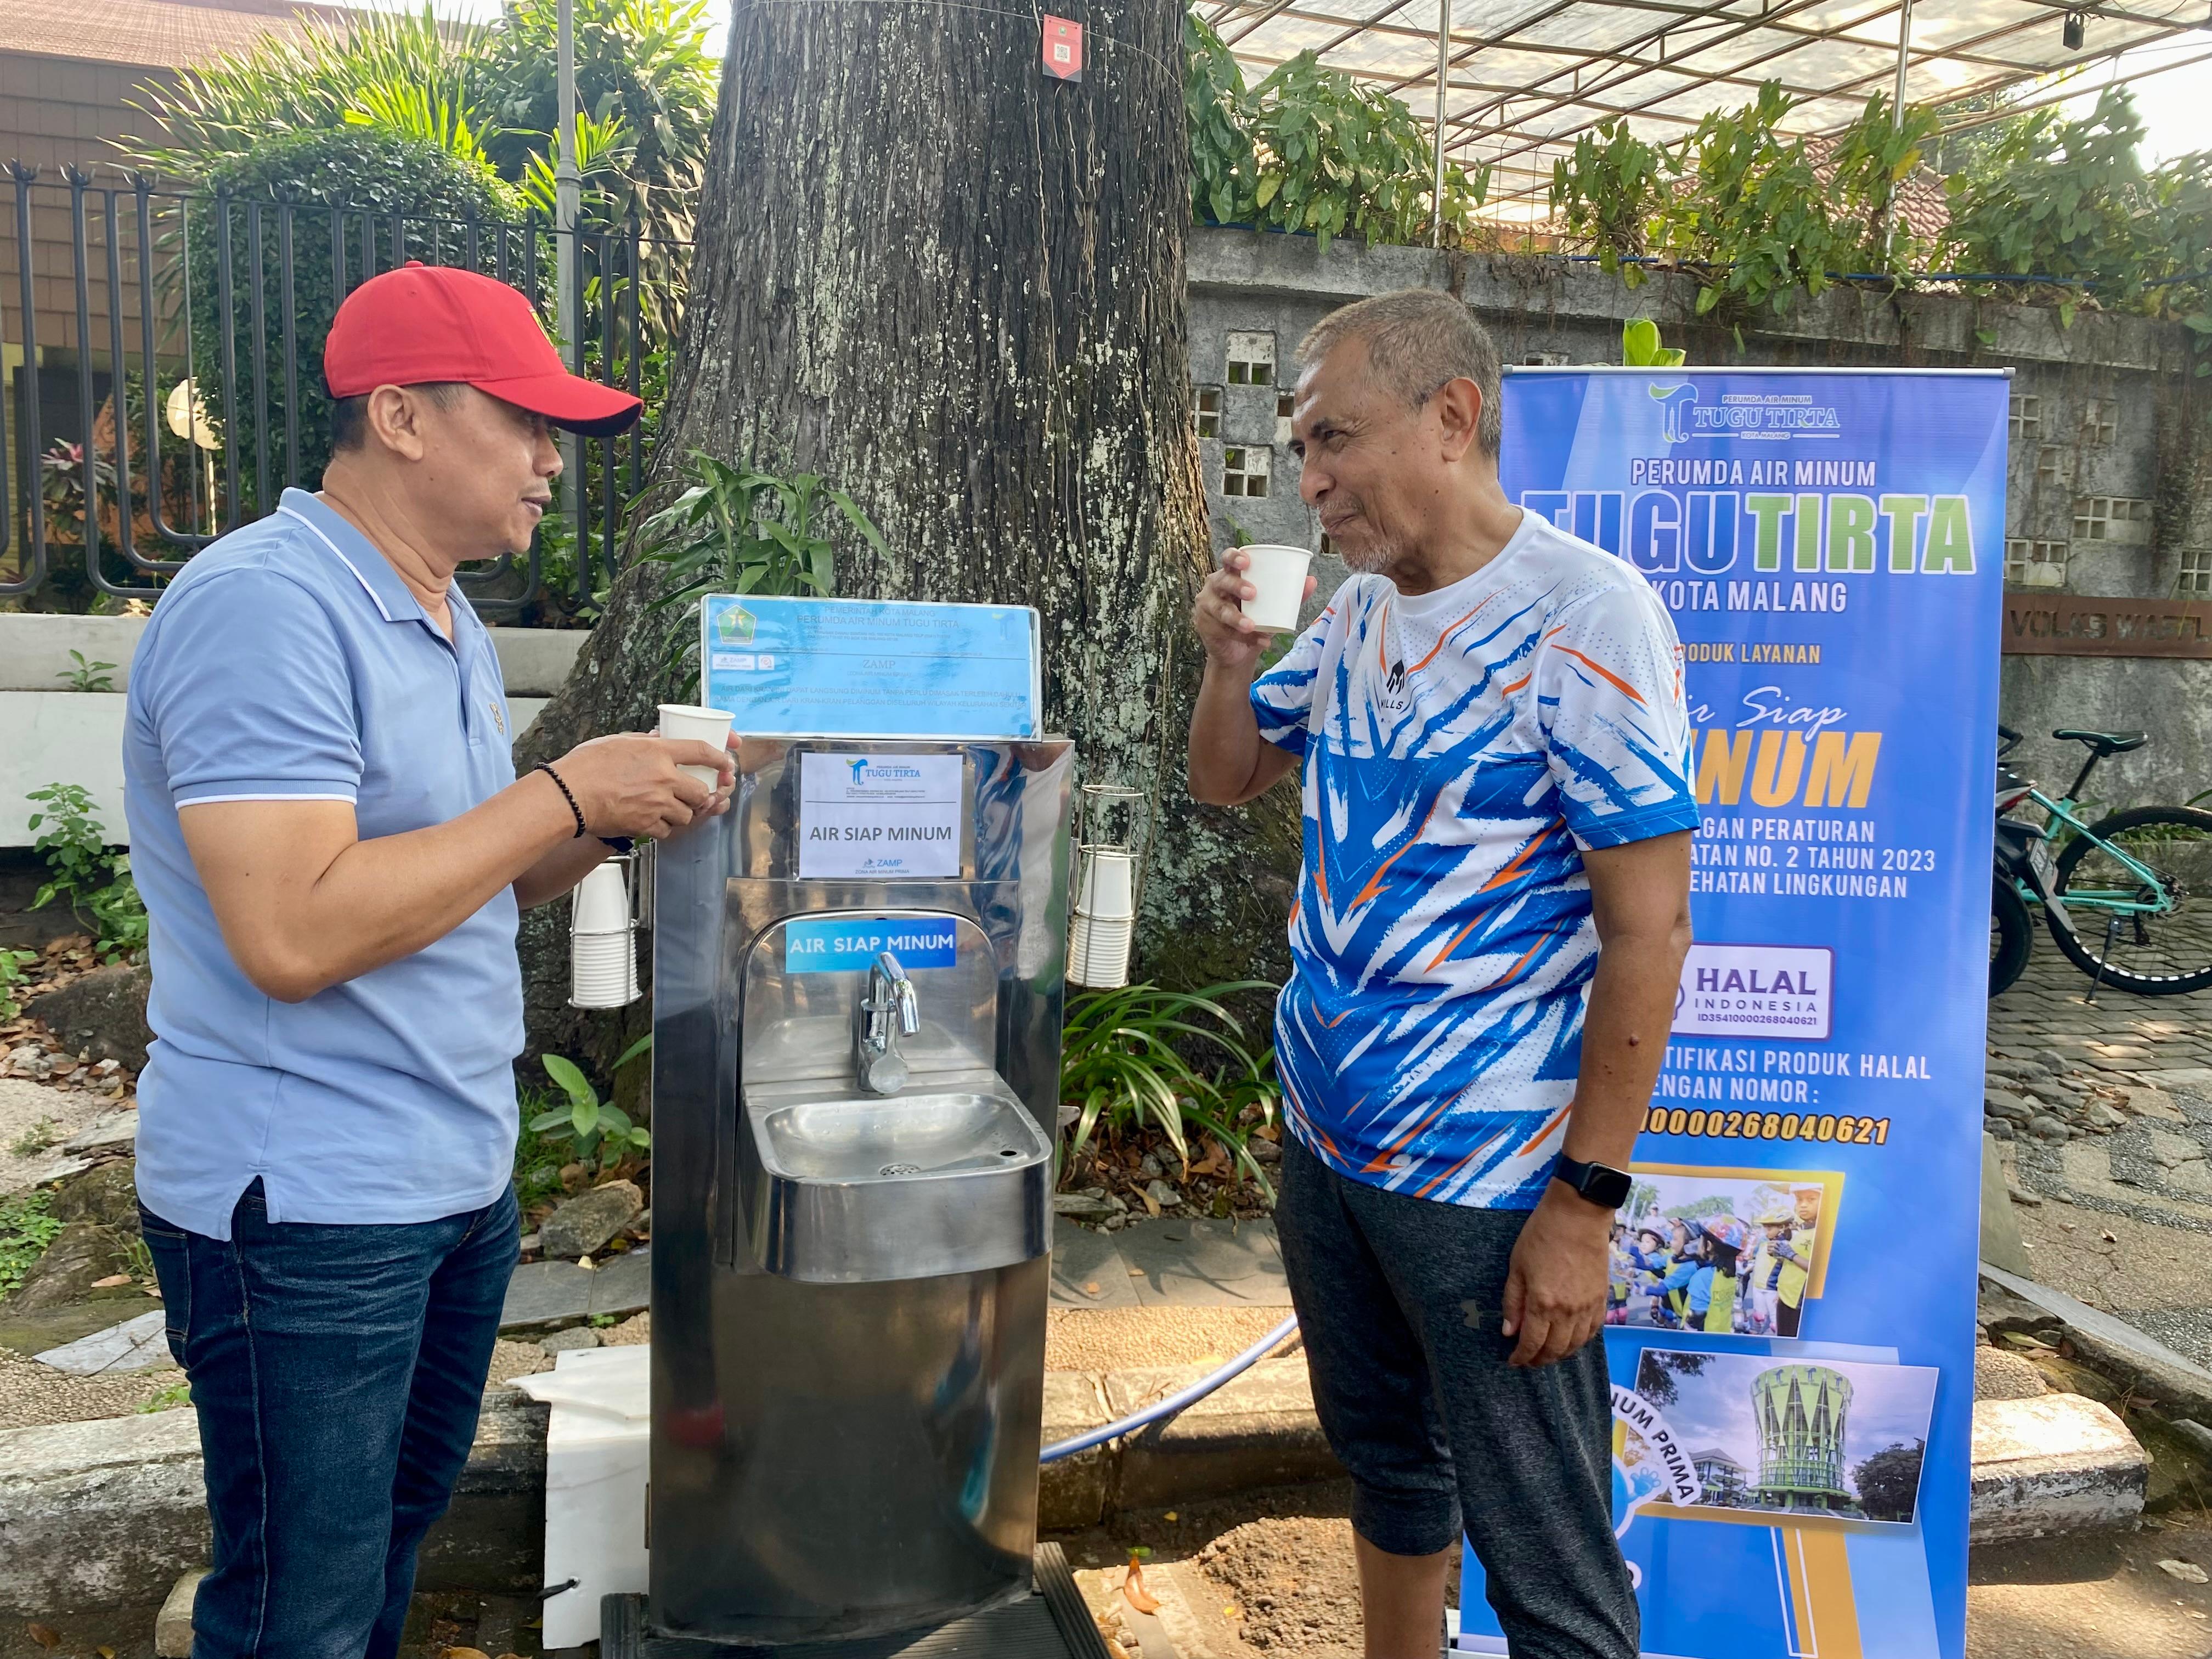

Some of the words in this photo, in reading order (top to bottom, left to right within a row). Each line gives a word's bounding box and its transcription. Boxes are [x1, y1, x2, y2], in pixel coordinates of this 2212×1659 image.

[1722, 396, 1762, 404] PERUMDA
[1692, 407, 1762, 428] TUGU
[1765, 408, 1840, 428] TIRTA
[1632, 460, 1742, 486] PERUMDA
[1750, 461, 1787, 486] AIR
[1795, 462, 1875, 487] MINUM
[1652, 580, 1719, 611] KOTA
[1728, 581, 1847, 612] MALANG
[797, 615, 847, 625] PERUMDA
[848, 617, 865, 625] AIR
[867, 618, 900, 627] MINUM
[903, 619, 930, 628] TUGU
[933, 620, 960, 628] TIRTA
[825, 606, 877, 615] PEMERINTAH
[862, 659, 896, 669] ZAMP
[1741, 644, 1820, 664] LAYANAN
[1736, 686, 1848, 742] Siap
[865, 769, 892, 777] TUGU
[894, 769, 921, 777] TIRTA
[1690, 729, 1882, 808] NUM
[809, 826, 839, 841] AIR
[844, 827, 882, 841] SIAP
[888, 826, 952, 841] MINUM
[1751, 819, 1875, 842] PERATURAN
[1745, 845, 1778, 868] NO.
[1786, 847, 1799, 867] 2
[1808, 848, 1874, 870] TAHUN
[1882, 850, 1936, 872] 2023
[1690, 871, 1767, 894] EHATAN
[1773, 874, 1908, 898] LINGKUNGAN
[790, 938, 826, 953] AIR
[834, 936, 882, 952] SIAP
[887, 934, 953, 950] MINUM
[1696, 968, 1817, 996] HALAL
[1695, 998, 1816, 1013] INDONESIA
[1697, 1013, 1817, 1026] ID35410000268040621
[1665, 1046, 1755, 1073] TIFIKASI
[1763, 1050, 1852, 1077] PRODUK
[1860, 1054, 1932, 1080] HALAL
[1730, 1077, 1809, 1104] NOMOR
[1651, 1429, 1695, 1500] PRIMA
